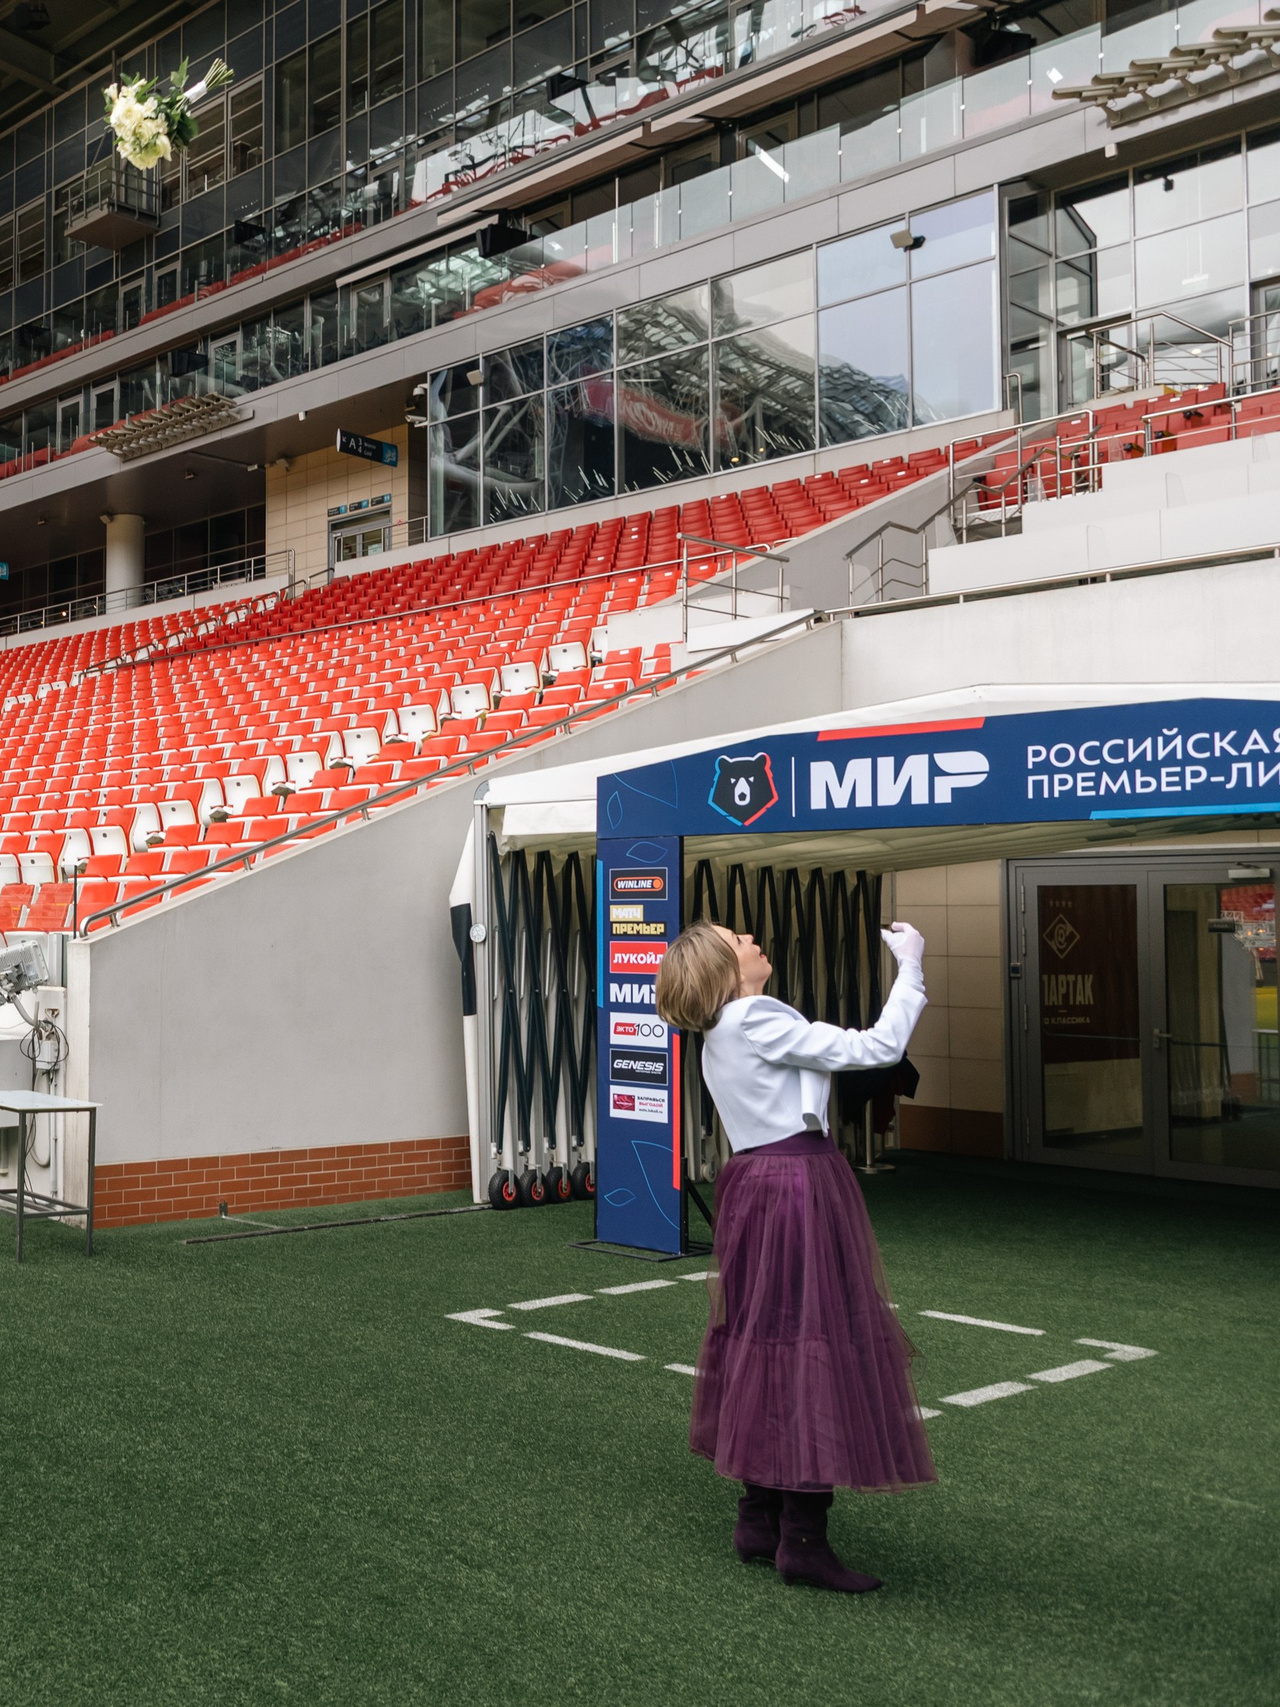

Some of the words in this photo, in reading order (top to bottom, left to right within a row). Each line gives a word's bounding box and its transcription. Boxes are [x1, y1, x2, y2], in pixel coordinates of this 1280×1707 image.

[810, 751, 990, 810] МИР
[617, 880, 652, 889] WINLINE
[612, 908, 640, 919] МАТЧ
[612, 923, 665, 935] ПРЕМЬЕР
[609, 983, 656, 1004] МИ
[615, 1025, 634, 1033] ЭКТО
[613, 1059, 664, 1072] GENESIS
